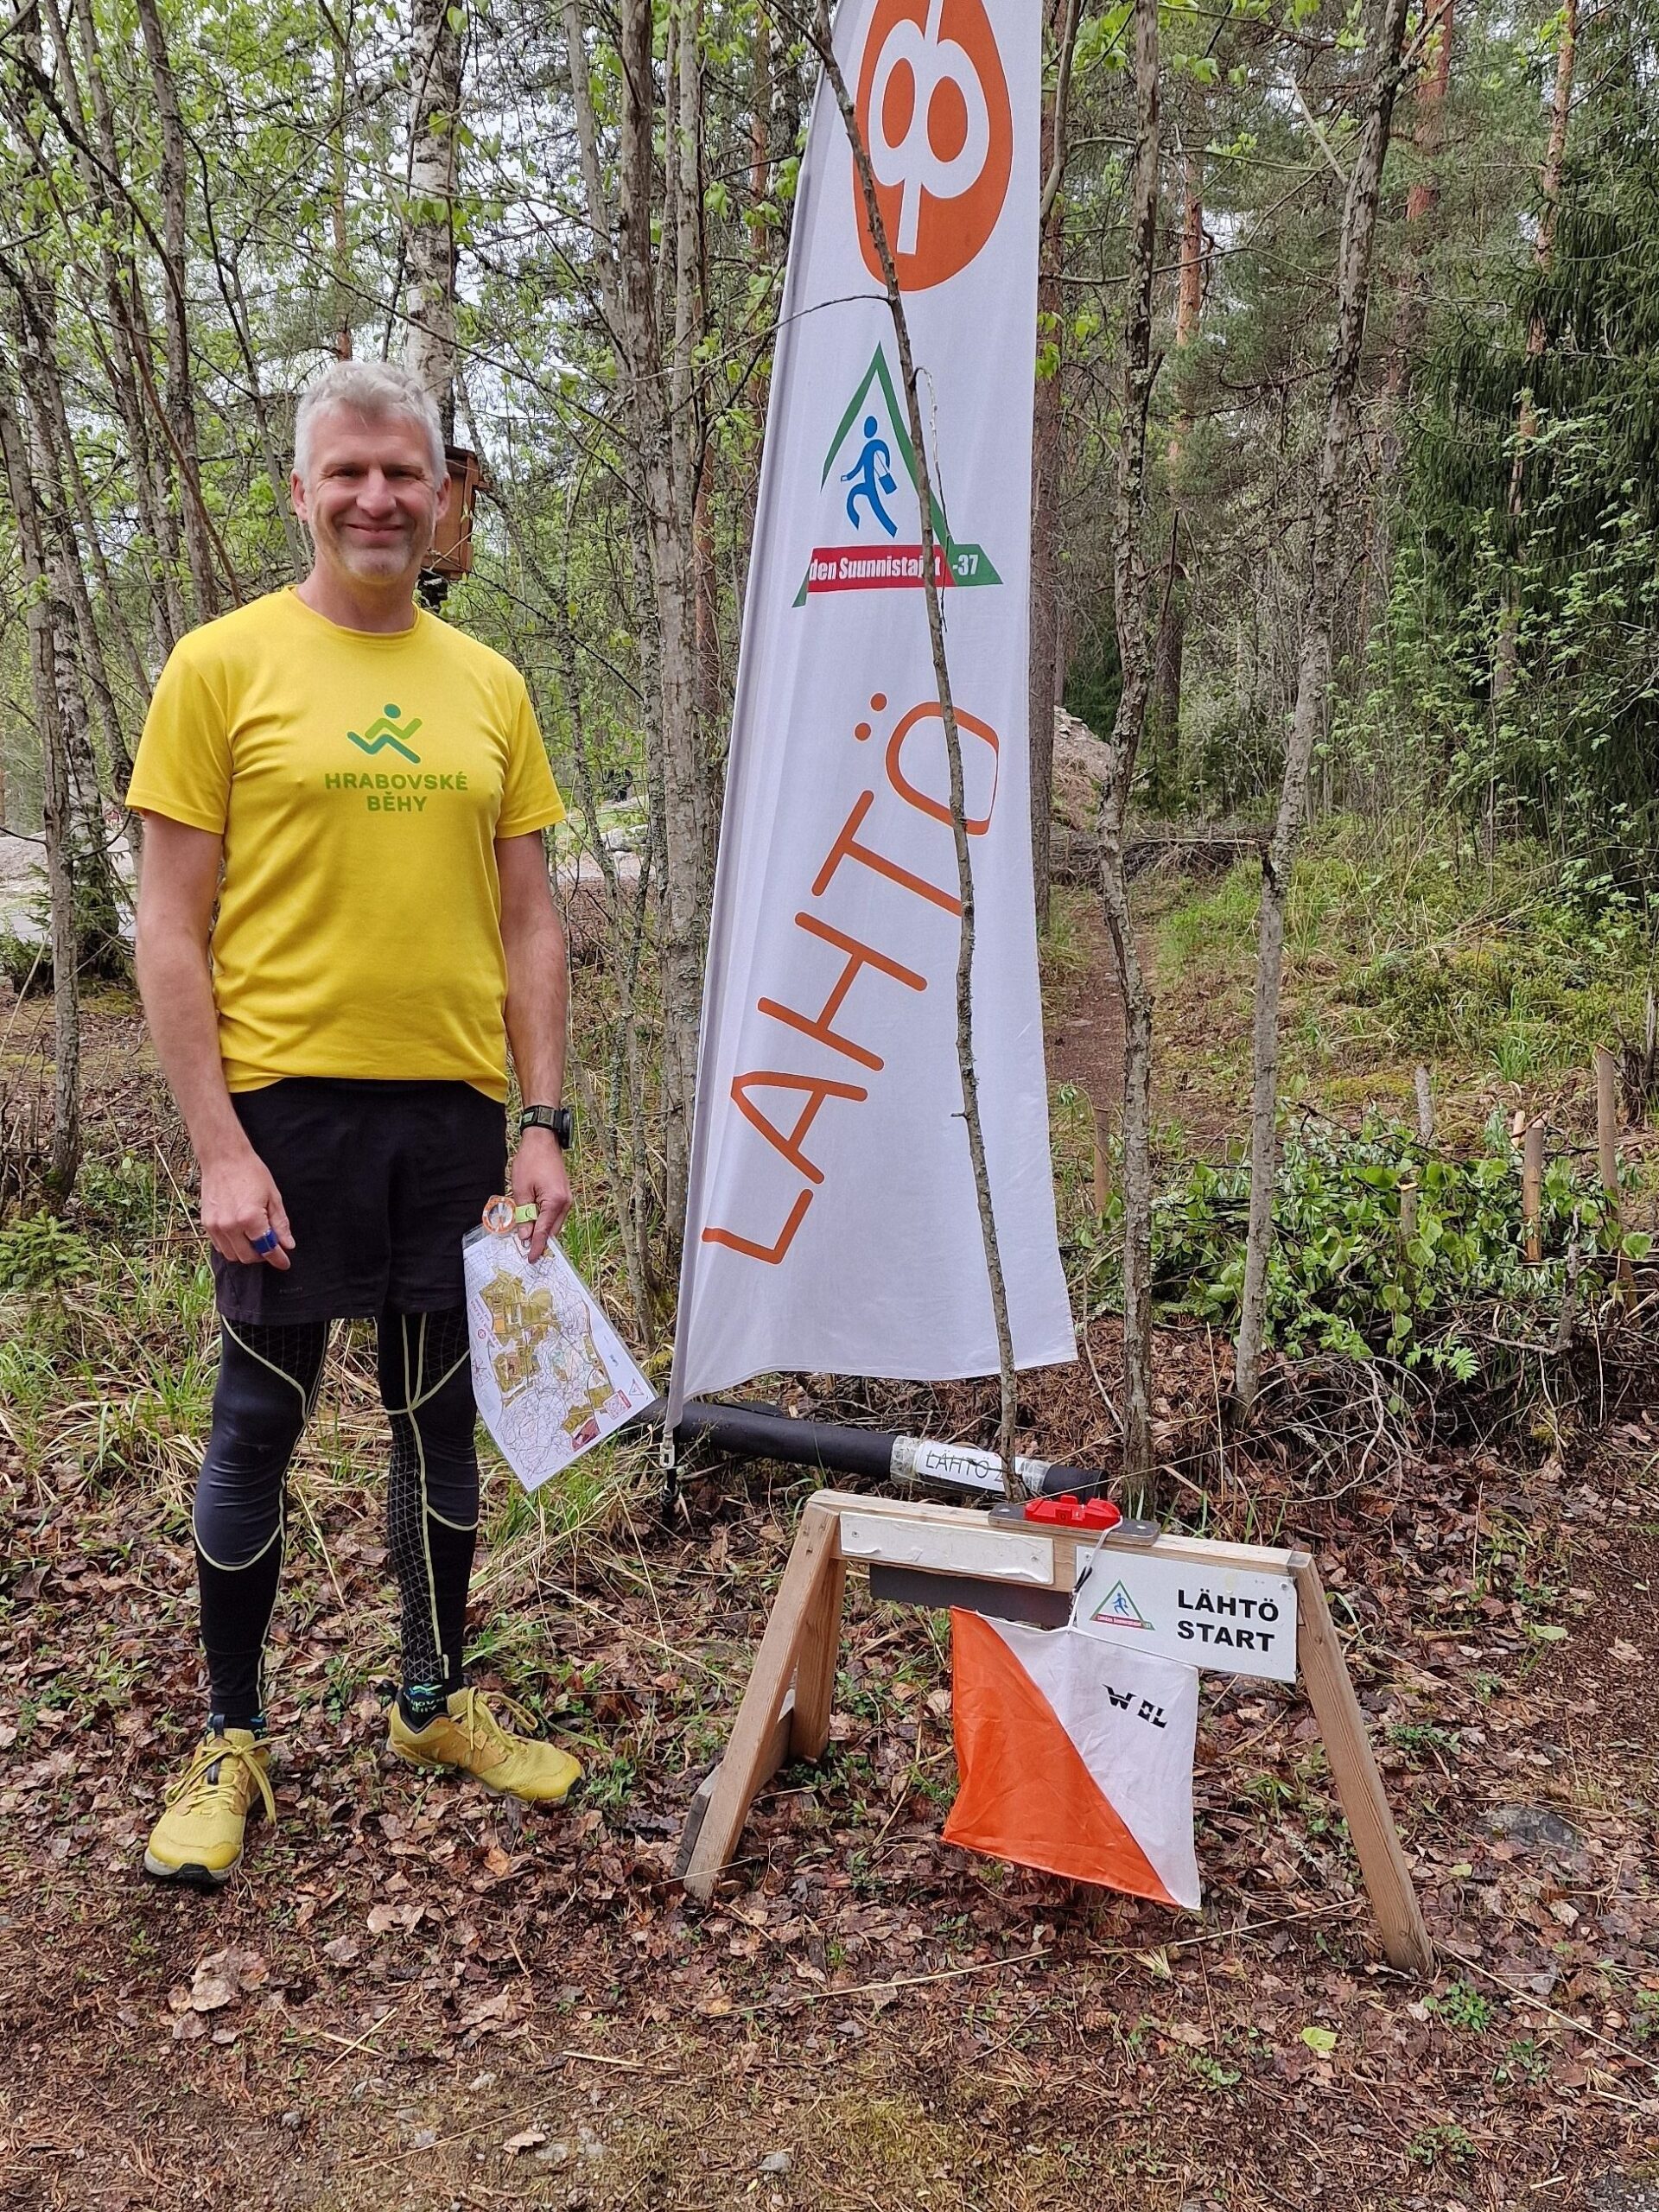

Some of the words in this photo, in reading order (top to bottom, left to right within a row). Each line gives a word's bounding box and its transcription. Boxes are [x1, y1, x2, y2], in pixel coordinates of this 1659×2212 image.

[839, 555, 941, 580] Suunnistajt
[952, 554, 979, 576] -37
[324, 771, 469, 791] HRABOVSKÉ
[366, 791, 428, 812] BĚHY
[925, 1449, 990, 1479] LÄHTÖ
[1178, 1587, 1280, 1623] LÄHTÖ
[1177, 1619, 1275, 1653] START
